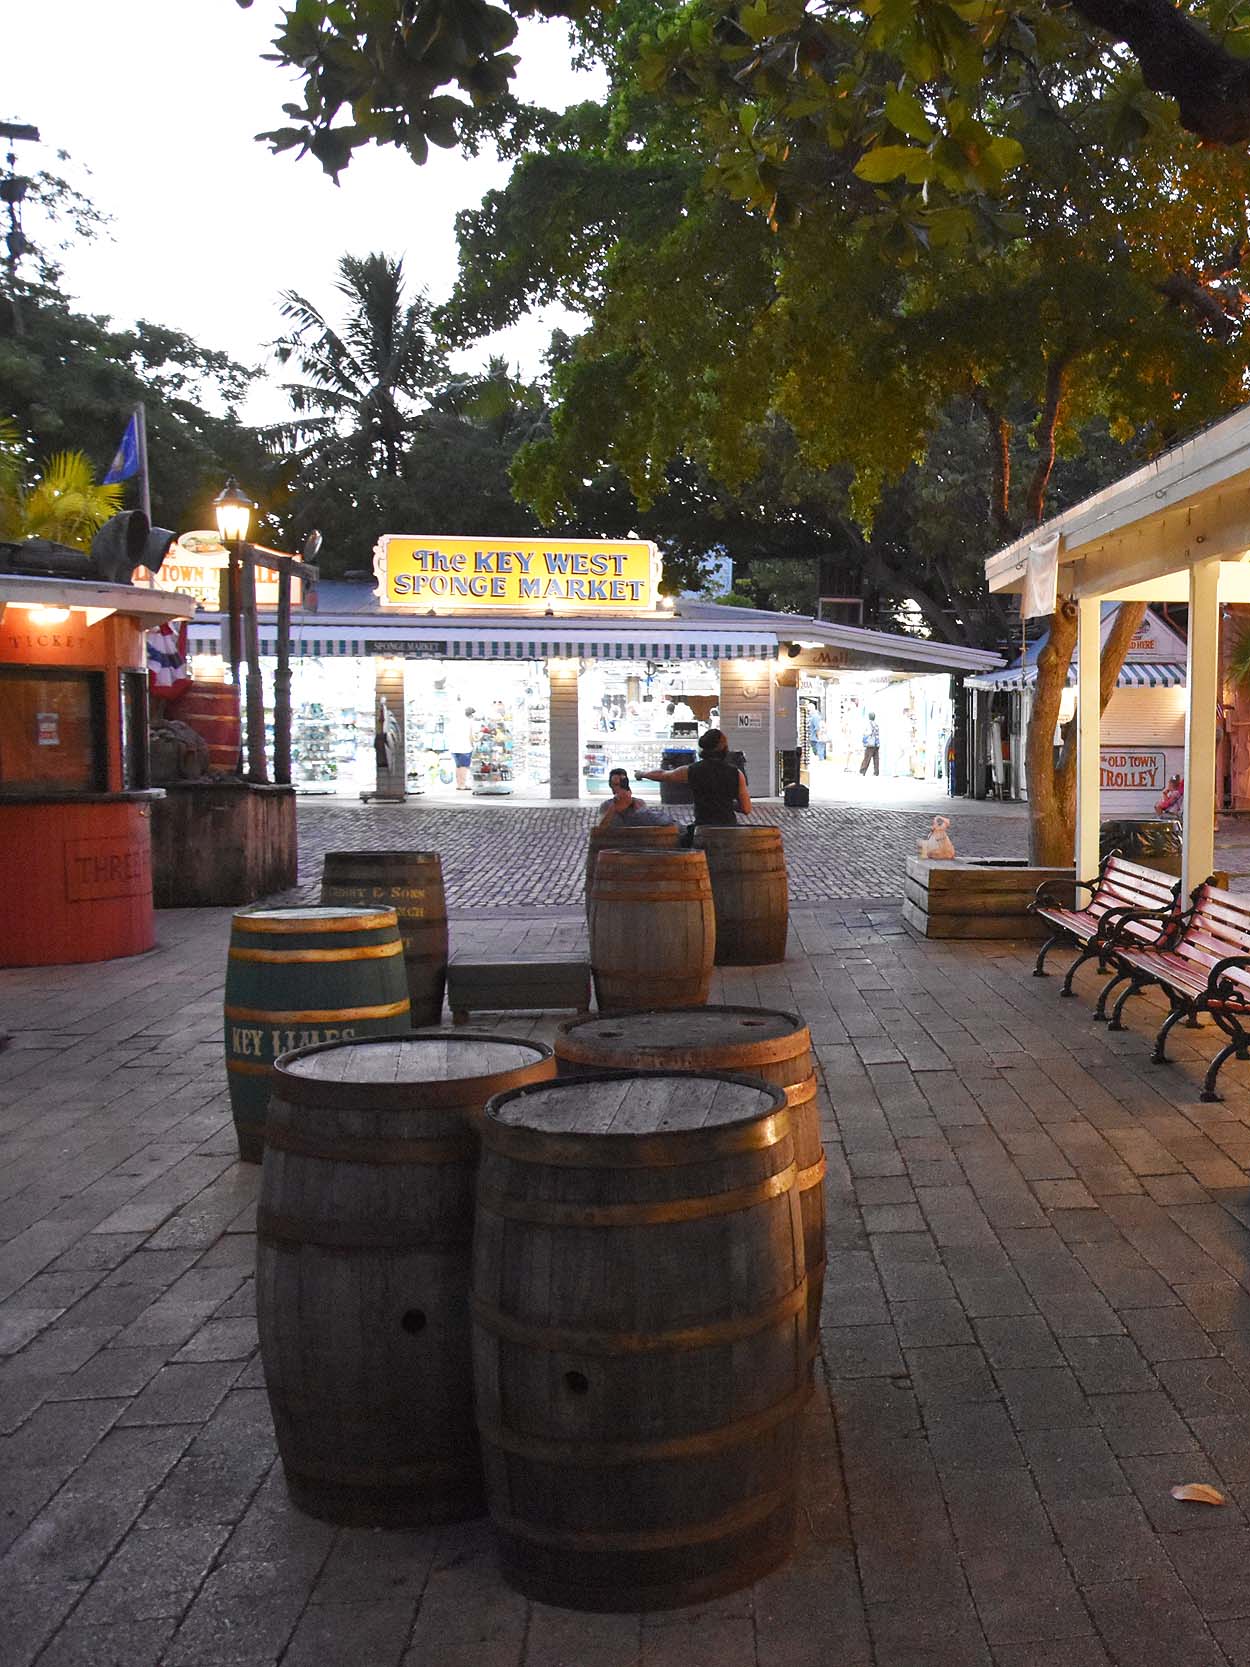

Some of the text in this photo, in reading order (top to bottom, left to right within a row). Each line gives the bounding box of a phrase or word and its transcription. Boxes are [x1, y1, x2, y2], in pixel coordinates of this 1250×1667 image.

[412, 550, 628, 577] The KEY WEST
[161, 566, 204, 581] TOWN
[394, 574, 645, 601] SPONGE MARKET
[374, 641, 440, 652] SPONGE MARKET
[812, 652, 849, 664] Mall
[738, 714, 749, 726] NO
[1108, 756, 1127, 768] OLD
[1129, 755, 1157, 768] TOWN
[1100, 767, 1159, 788] TROLLEY
[231, 1027, 264, 1057] KEY
